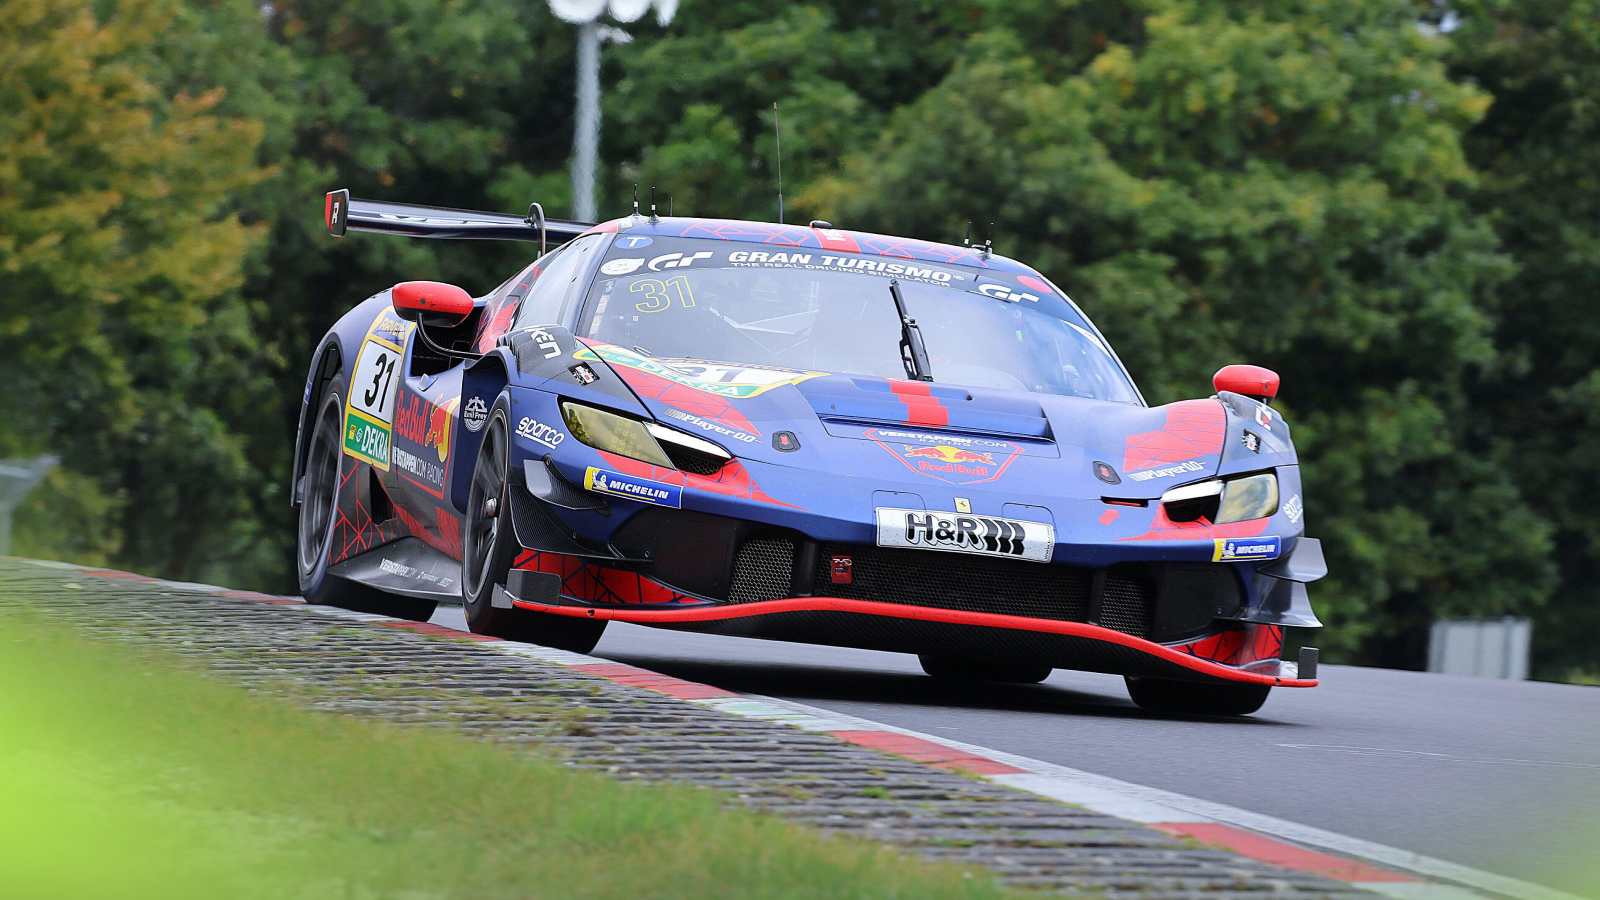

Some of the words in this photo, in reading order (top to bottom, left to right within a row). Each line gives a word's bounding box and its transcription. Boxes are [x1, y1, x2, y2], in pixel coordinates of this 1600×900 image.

[728, 251, 812, 263] GRAN
[821, 255, 952, 282] TURISMO
[805, 264, 865, 274] DRIVING
[867, 271, 950, 287] SIMULATOR
[630, 274, 696, 313] 31
[364, 353, 396, 413] 31
[361, 425, 388, 465] DEKRA
[517, 416, 565, 449] sparco
[878, 430, 1007, 448] VERSTAPPEN.COM
[610, 480, 669, 499] MICHELIN
[906, 513, 982, 549] H&R
